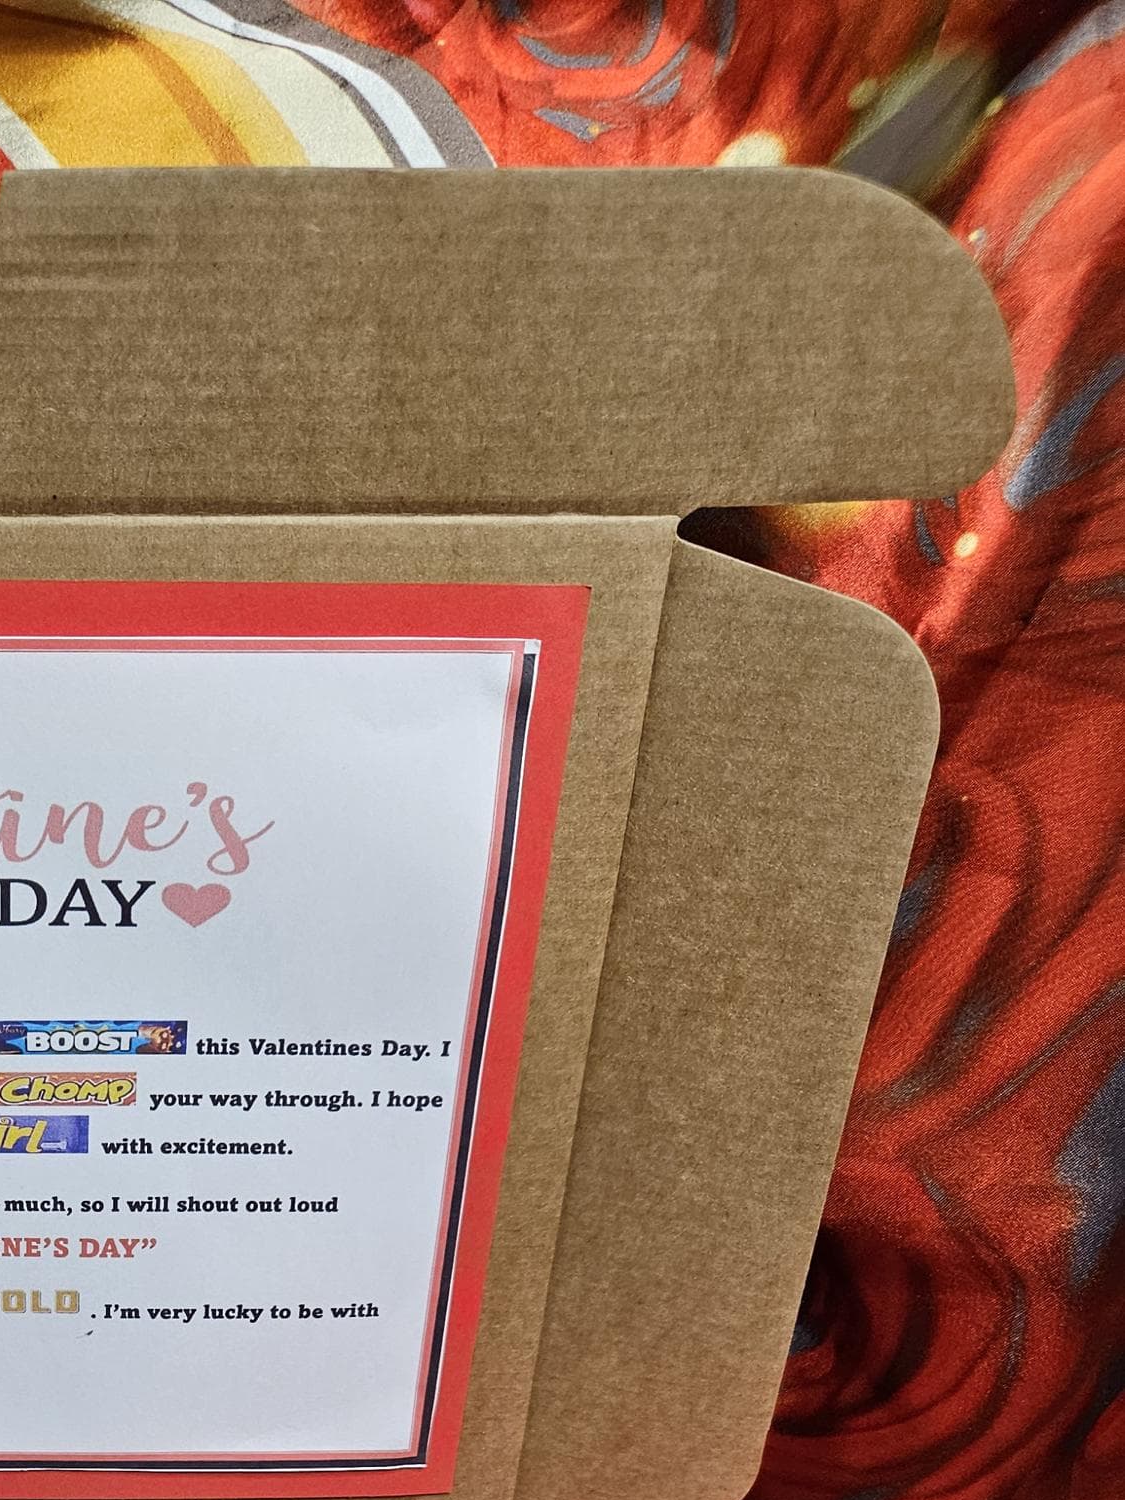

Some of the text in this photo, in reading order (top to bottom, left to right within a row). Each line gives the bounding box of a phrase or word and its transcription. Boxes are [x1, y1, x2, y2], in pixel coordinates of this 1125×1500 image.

[26, 1030, 138, 1052] BOOST
[195, 1037, 240, 1056] this
[248, 1038, 372, 1057] Valentines
[380, 1039, 431, 1062] Day.
[440, 1040, 452, 1057] I
[149, 1093, 204, 1112] your
[208, 1094, 258, 1112] way
[264, 1089, 363, 1113] through.
[370, 1090, 381, 1108] I
[386, 1090, 443, 1112] hope
[101, 1137, 154, 1155] with
[159, 1137, 293, 1155] excitement.
[3, 1195, 73, 1217] much,
[80, 1200, 105, 1213] so
[111, 1196, 120, 1213] I
[126, 1196, 170, 1213] will
[176, 1195, 239, 1213] shout
[245, 1197, 283, 1213] out
[288, 1196, 339, 1213] loud
[79, 1237, 158, 1259] DAY"
[103, 1303, 141, 1319] I'm
[146, 1308, 197, 1324] very
[202, 1303, 264, 1324] lucky
[269, 1304, 292, 1320] to
[298, 1303, 324, 1319] be
[330, 1302, 380, 1319] with
